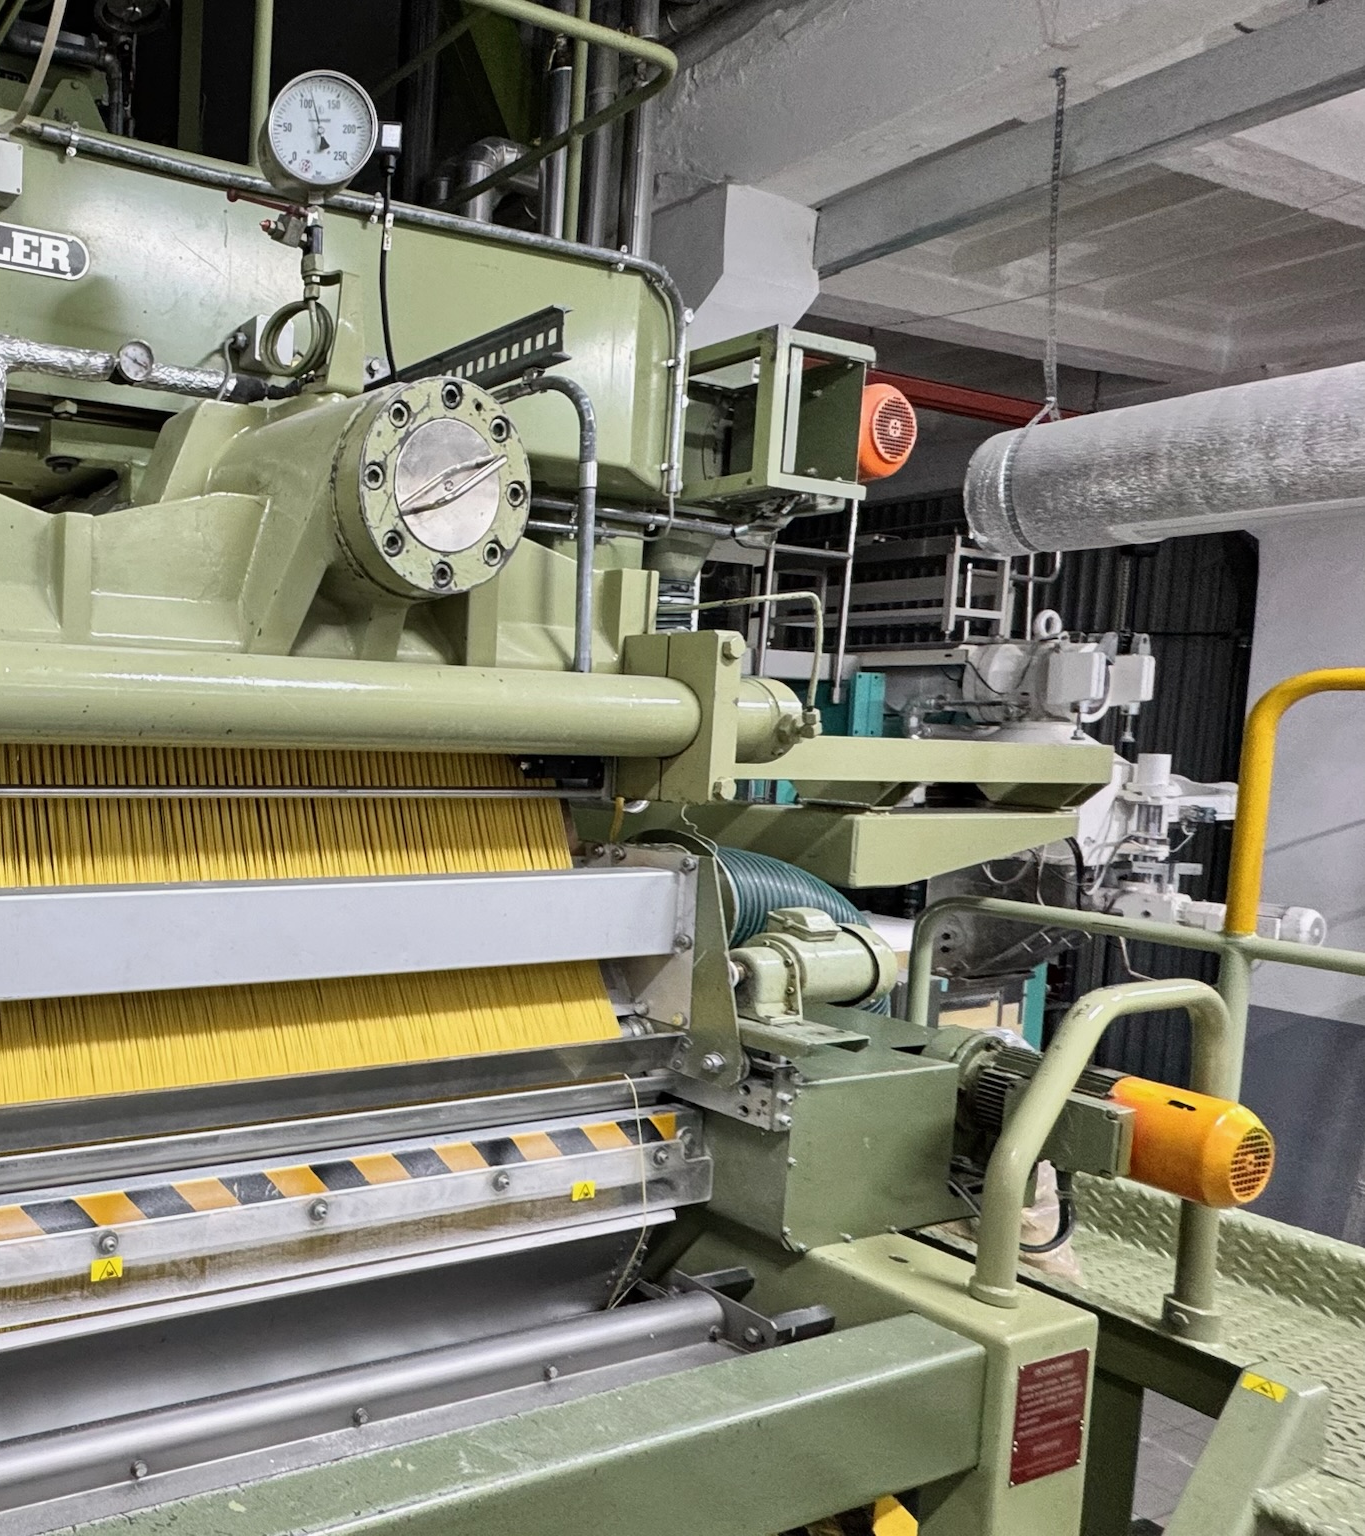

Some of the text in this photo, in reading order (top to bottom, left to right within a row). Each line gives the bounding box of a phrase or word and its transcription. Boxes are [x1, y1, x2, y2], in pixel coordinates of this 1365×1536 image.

[300, 100, 313, 109] 100
[327, 100, 340, 110] 150
[283, 123, 292, 132] 50
[343, 124, 355, 134] 200
[292, 151, 297, 160] 0
[334, 151, 347, 160] 250
